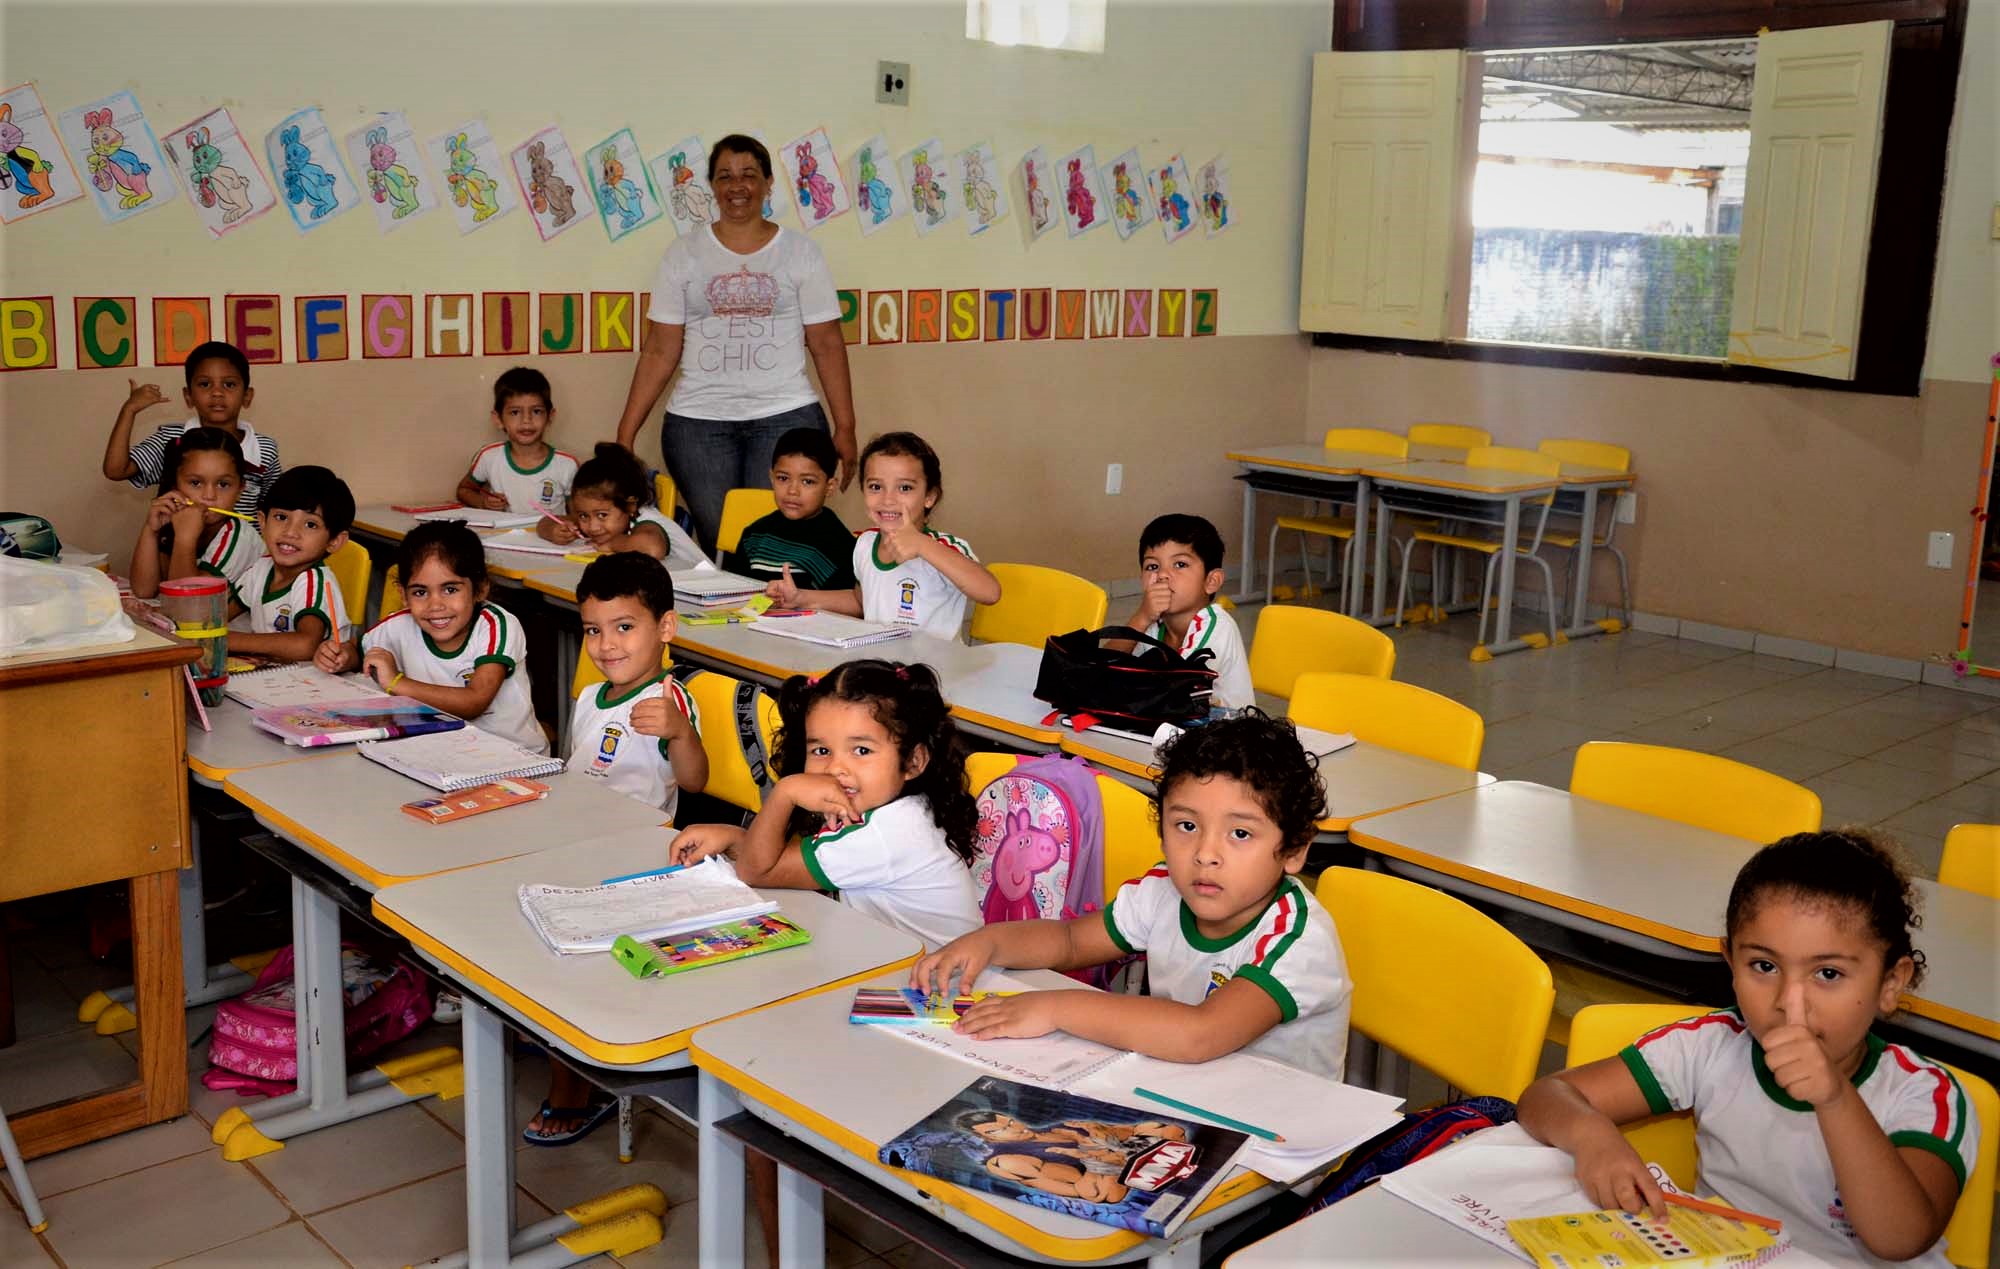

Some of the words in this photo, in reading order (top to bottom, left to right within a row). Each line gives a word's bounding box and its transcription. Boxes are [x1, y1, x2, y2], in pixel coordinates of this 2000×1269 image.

[1, 300, 48, 367] B
[83, 299, 130, 367] C
[165, 300, 207, 363] D
[235, 300, 275, 359] E
[304, 300, 343, 361] F
[368, 295, 405, 357] G
[431, 295, 470, 355] H
[501, 296, 513, 350] I
[542, 295, 574, 350] J
[599, 295, 631, 349] K
[836, 290, 858, 323] P
[872, 294, 899, 341] Q
[914, 291, 940, 340] R
[952, 291, 976, 340] S
[988, 291, 1014, 340] T
[1025, 291, 1049, 338] U
[1060, 293, 1081, 336] V
[1094, 291, 1118, 336] W
[1127, 290, 1149, 334] X
[1163, 290, 1183, 332] Y
[1195, 292, 1213, 333] Z
[697, 343, 778, 372] CHIC
[542, 884, 617, 895] DESENHO
[906, 1030, 952, 1049] LIVRE
[964, 1051, 1049, 1083] DESENHO
[1126, 1144, 1193, 1191] MMA
